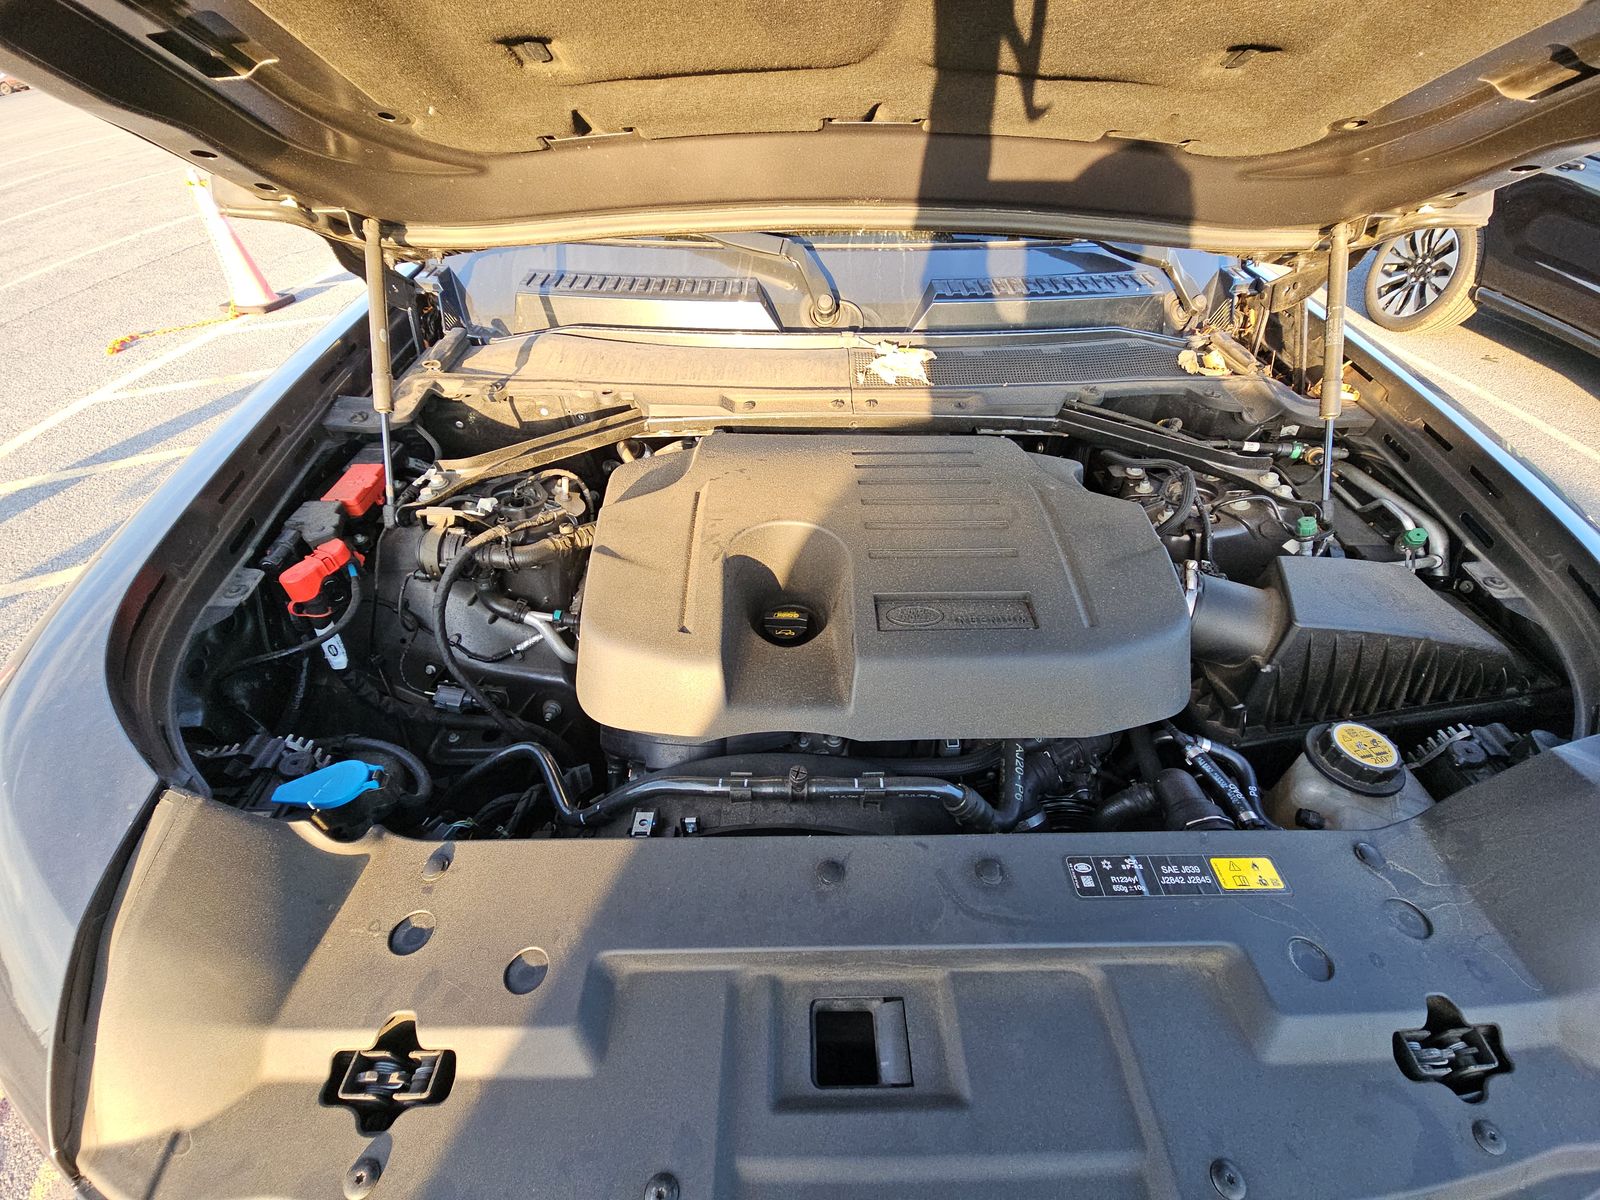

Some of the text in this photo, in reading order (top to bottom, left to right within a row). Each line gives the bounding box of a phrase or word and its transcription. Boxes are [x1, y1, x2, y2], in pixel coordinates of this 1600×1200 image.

[1161, 865, 1201, 874] SAE J639
[1161, 875, 1212, 885] J2842 J2845
